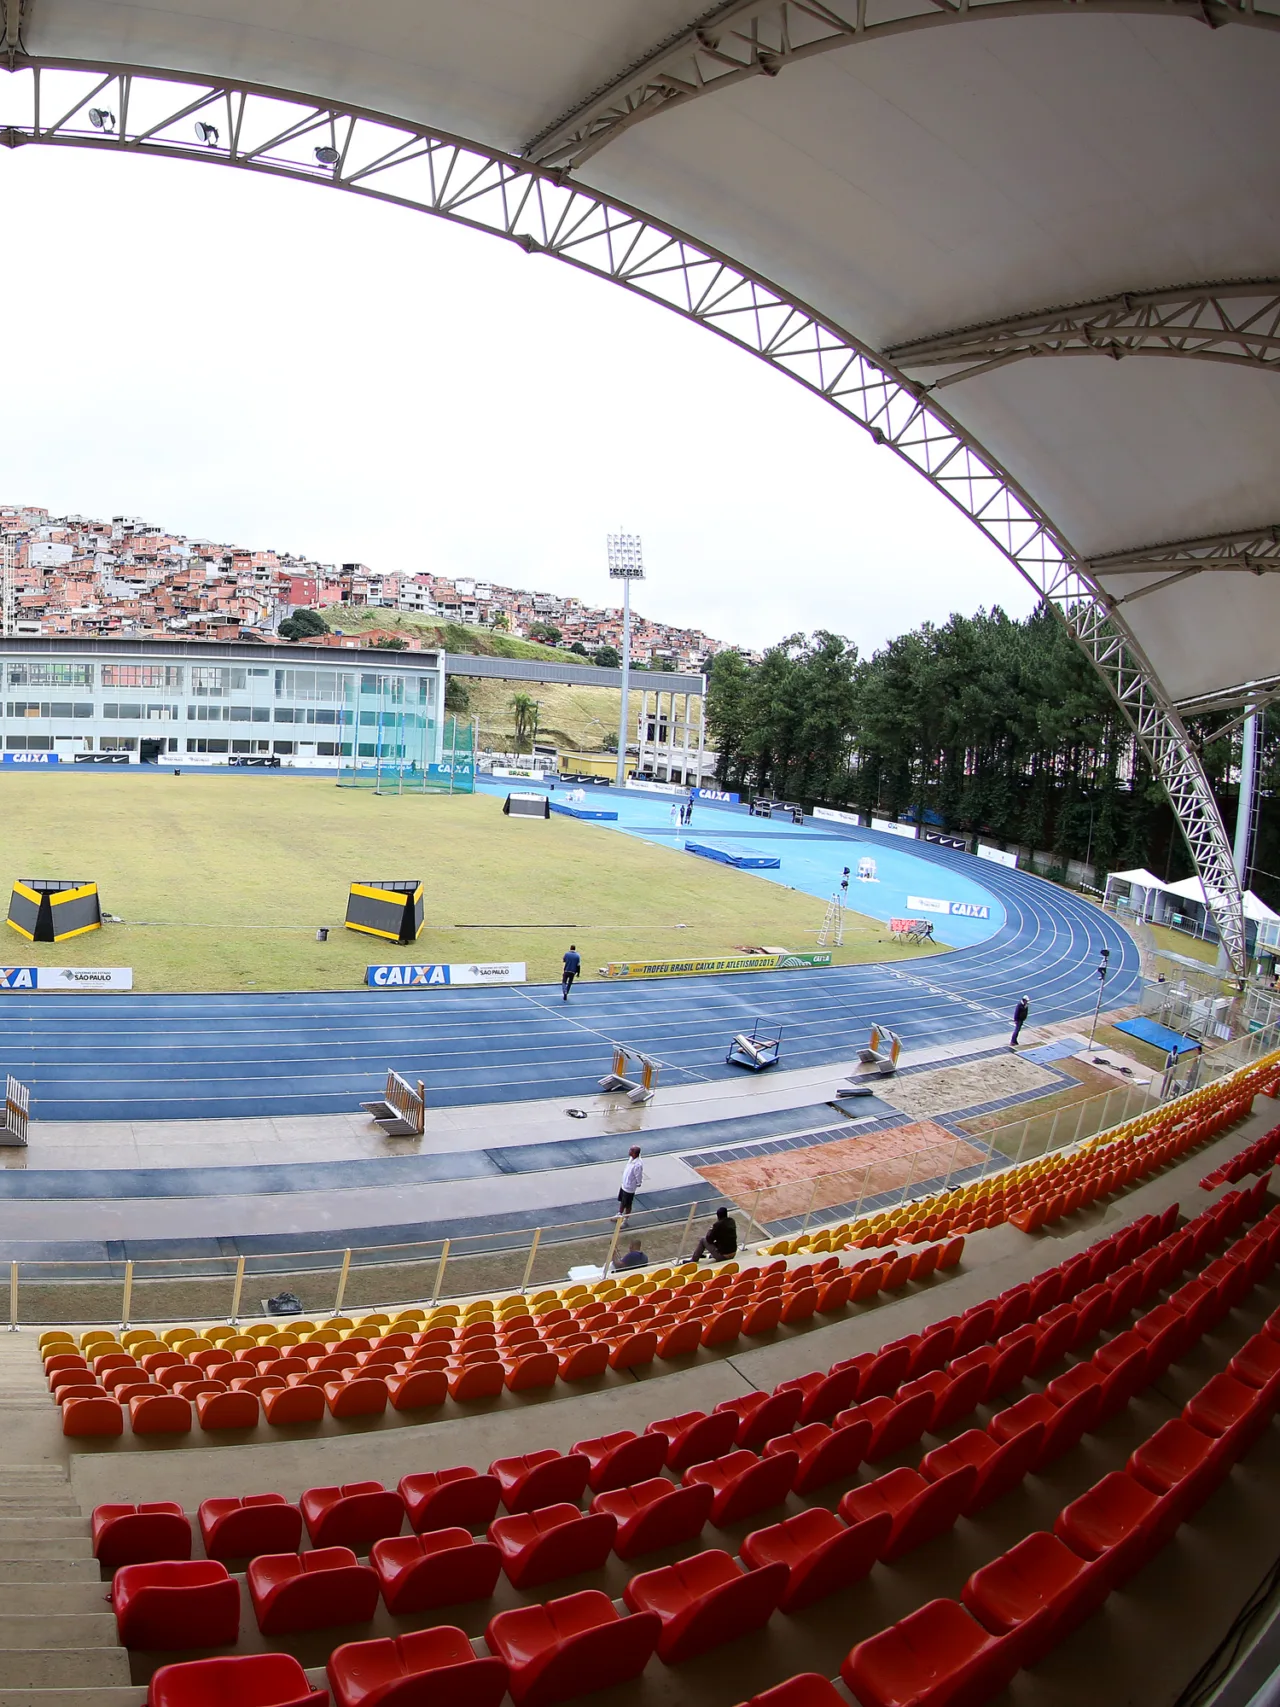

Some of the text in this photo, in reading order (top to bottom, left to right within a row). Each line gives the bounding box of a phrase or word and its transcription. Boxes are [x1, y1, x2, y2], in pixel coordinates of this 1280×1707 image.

[12, 755, 49, 763] CAIXA
[698, 789, 730, 802] CAIXA
[951, 903, 988, 918] CAIXA
[643, 963, 668, 974] TROFÉU
[671, 963, 693, 972] BRASIL
[696, 961, 714, 970] CAIXA
[717, 961, 724, 969] DE
[726, 959, 758, 968] ATLETISMO
[759, 958, 774, 966] 2015
[374, 966, 445, 985] CAIXA
